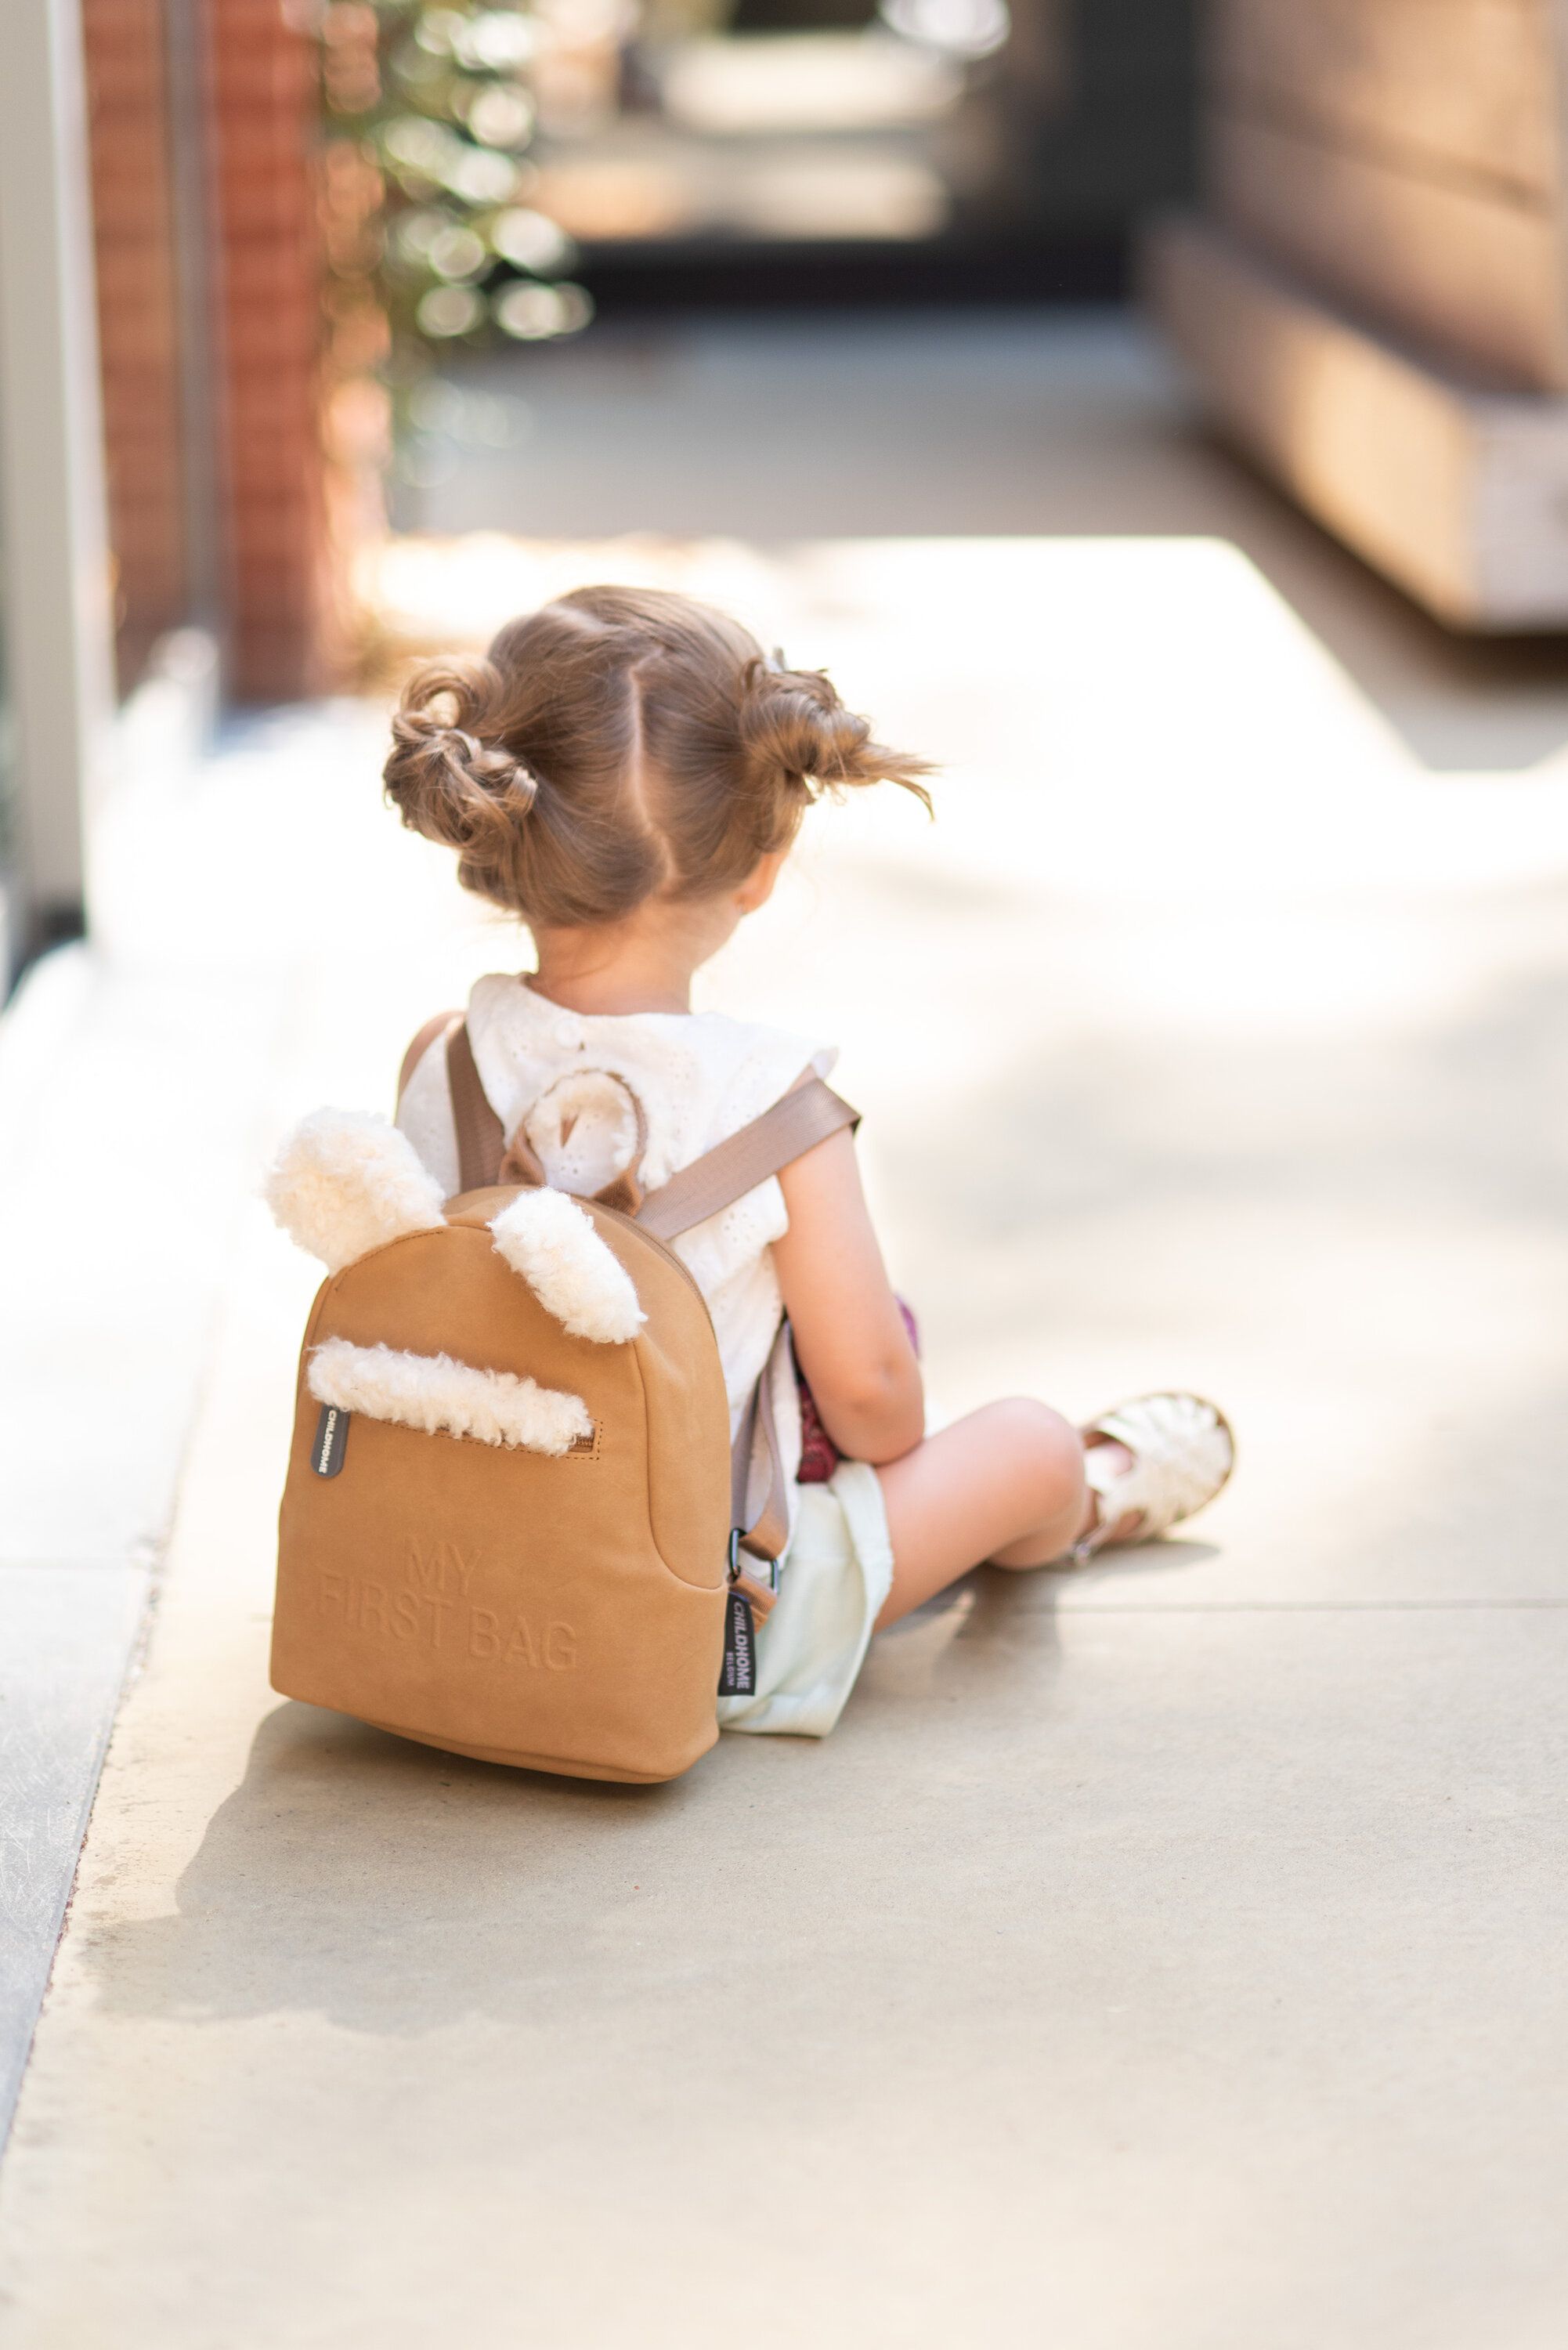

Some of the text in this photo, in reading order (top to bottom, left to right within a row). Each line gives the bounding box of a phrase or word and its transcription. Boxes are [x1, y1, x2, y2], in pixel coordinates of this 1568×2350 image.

[318, 1409, 338, 1473] CHILDHOME
[406, 1535, 482, 1596] MY
[316, 1571, 576, 1672] FIRST BAG
[734, 1601, 750, 1689] CHILDHOME
[726, 1650, 735, 1687] BELGIUM
